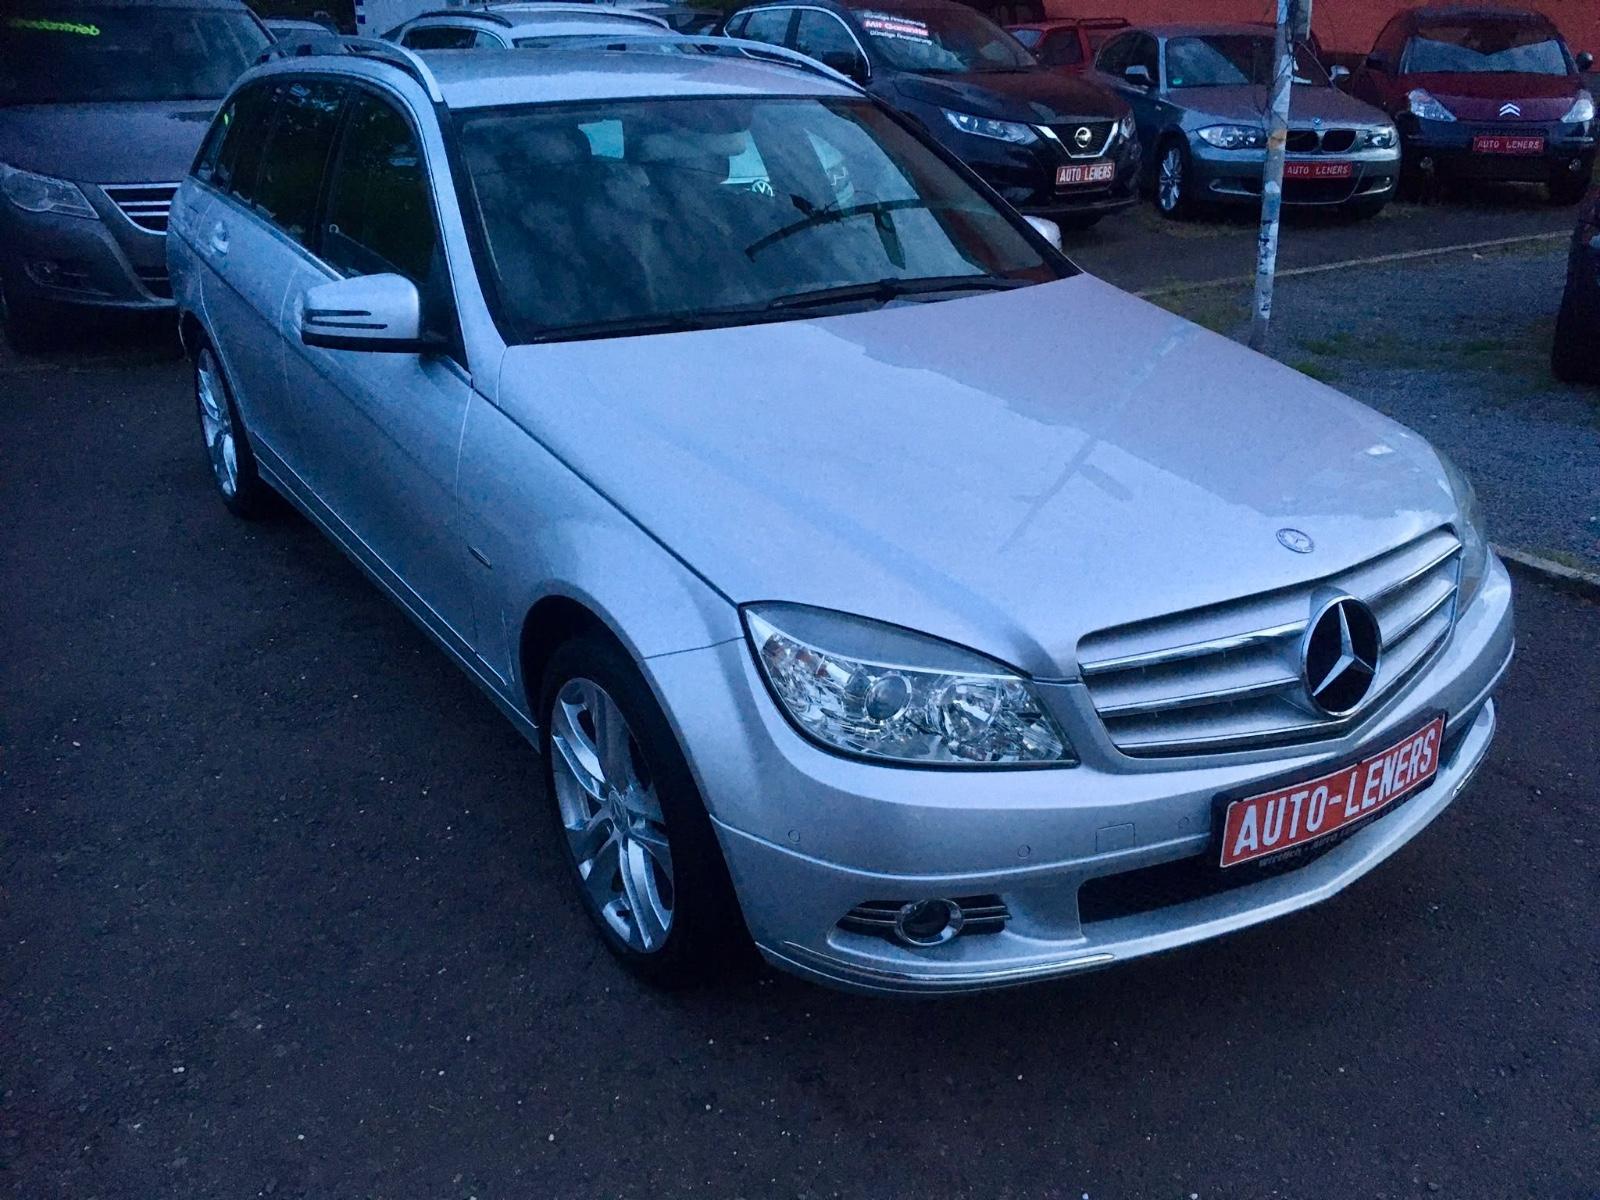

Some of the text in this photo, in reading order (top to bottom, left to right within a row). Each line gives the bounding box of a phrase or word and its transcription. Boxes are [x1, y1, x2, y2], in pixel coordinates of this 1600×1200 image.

[865, 20, 882, 29] Mit
[1477, 140, 1500, 149] AUTO
[1060, 167, 1082, 182] AUTO
[1287, 166, 1310, 175] AUTO
